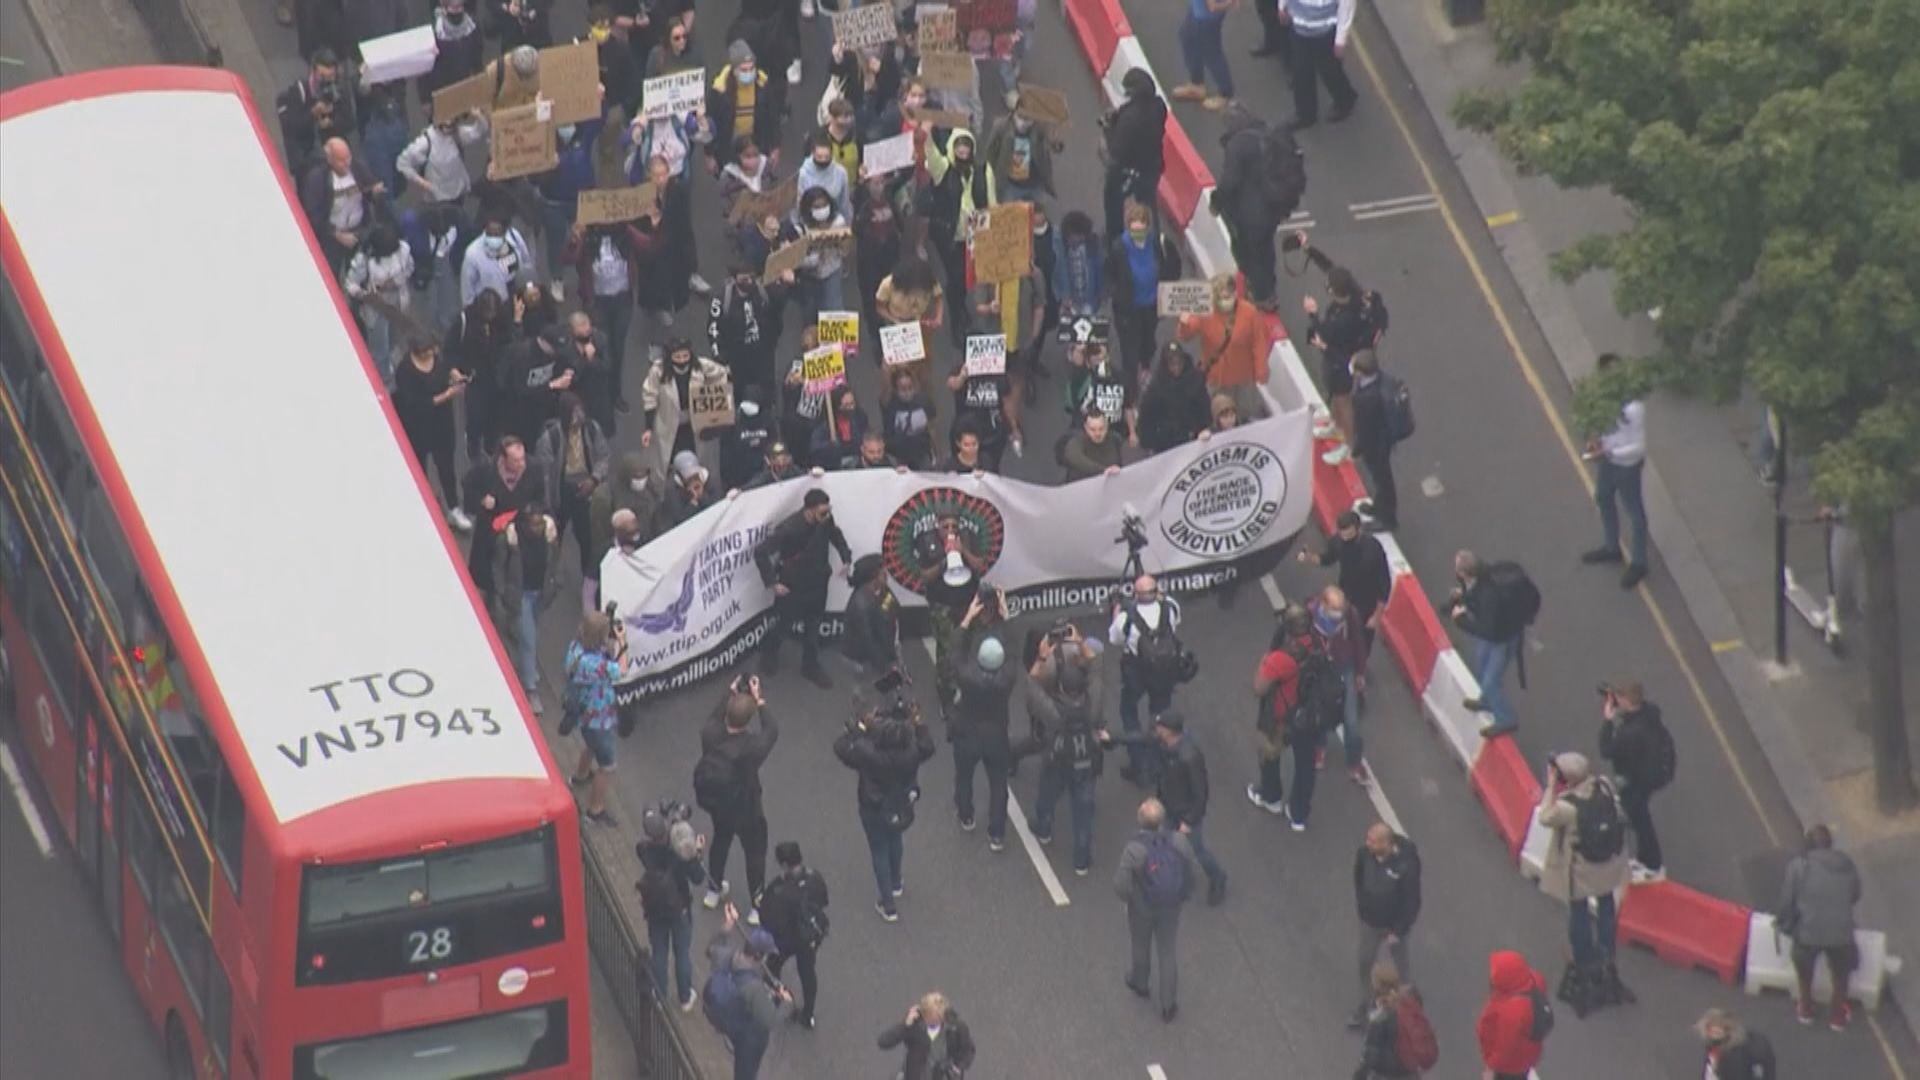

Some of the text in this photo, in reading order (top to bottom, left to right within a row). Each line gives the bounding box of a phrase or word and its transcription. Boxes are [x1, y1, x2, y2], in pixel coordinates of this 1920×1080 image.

[820, 319, 849, 328] BLACK
[820, 334, 858, 343] MATTER
[806, 352, 833, 367] BLACK
[1175, 447, 1270, 493] RACISM IS
[1196, 476, 1250, 500] THE RACE
[1188, 484, 1257, 512] OFFENDERS
[1194, 498, 1252, 519] REGISTER
[1169, 501, 1278, 553] UNCIVILISED
[698, 530, 742, 568] TAKING
[699, 546, 757, 590] INITIATIV
[702, 572, 735, 611] PARTY
[308, 668, 435, 713] TTO
[277, 708, 501, 769] VN37943
[408, 927, 452, 964] 28
